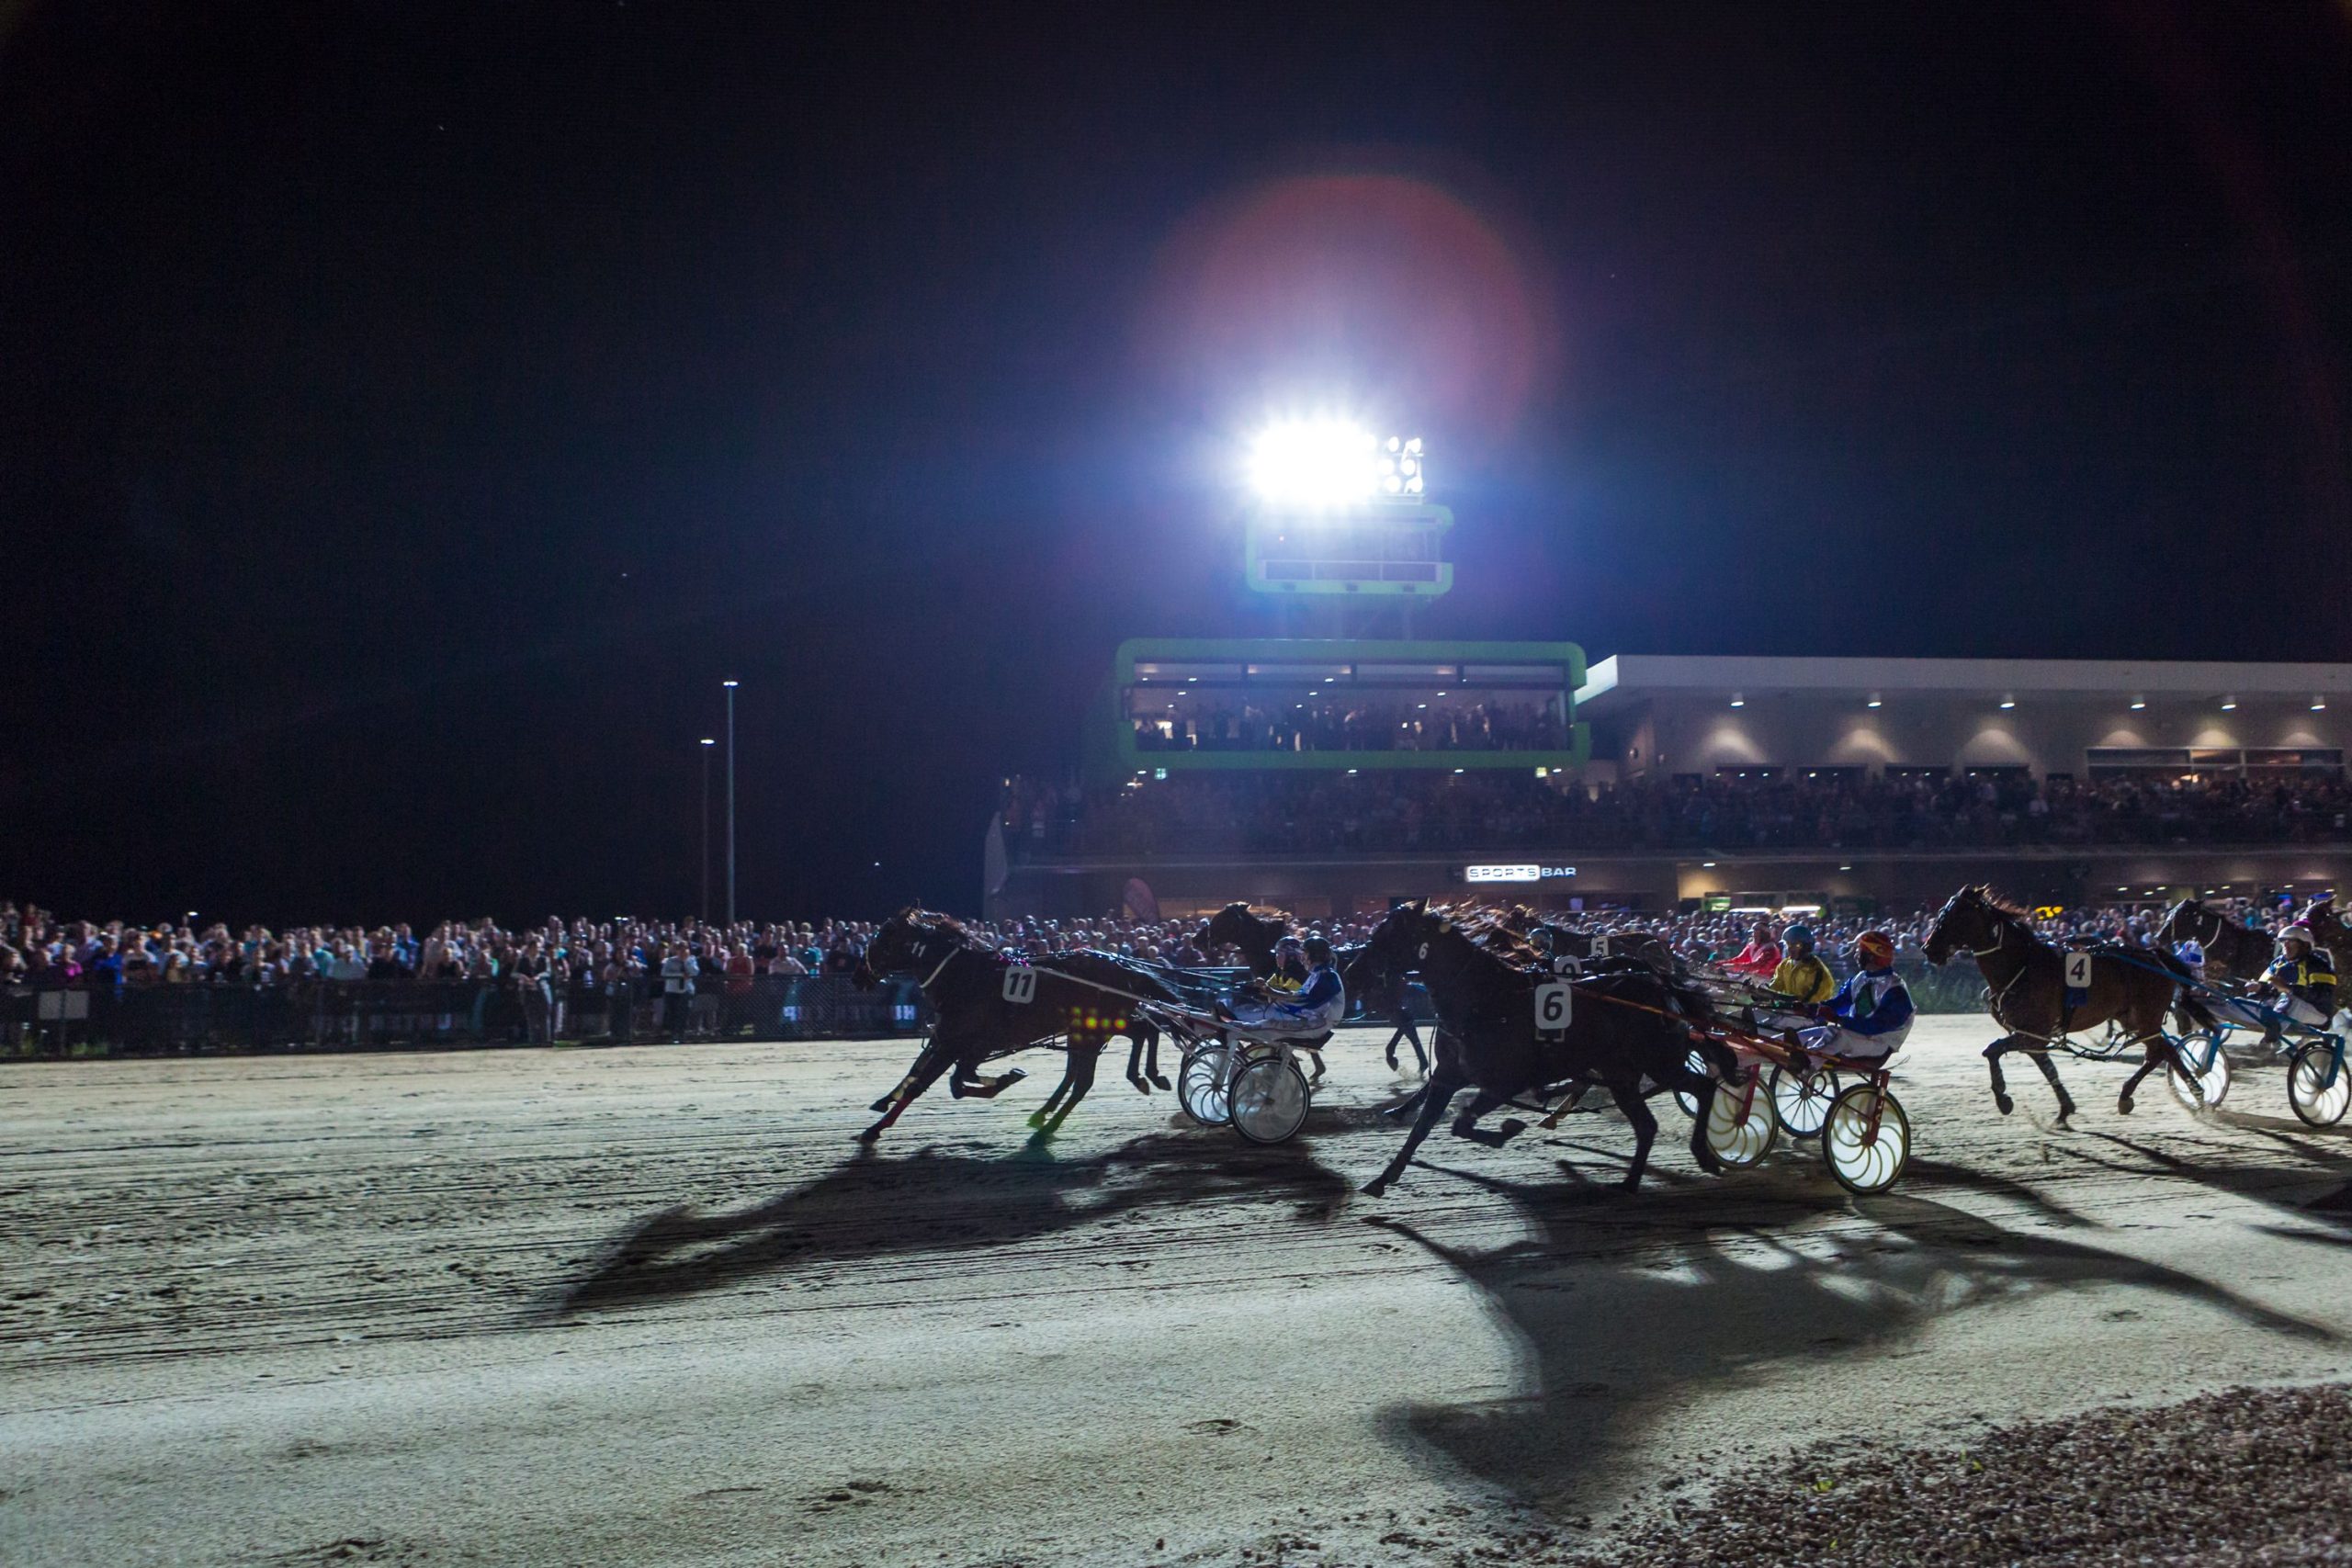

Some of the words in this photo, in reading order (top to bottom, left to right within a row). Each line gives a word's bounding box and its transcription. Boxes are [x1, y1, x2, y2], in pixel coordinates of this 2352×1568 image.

[1467, 866, 1539, 879] SPORTS
[1541, 866, 1577, 878] BAR
[910, 941, 927, 958] 11
[1418, 942, 1430, 960] 6
[2070, 958, 2086, 981] 4
[1008, 972, 1033, 998] 11
[1543, 990, 1564, 1021] 6
